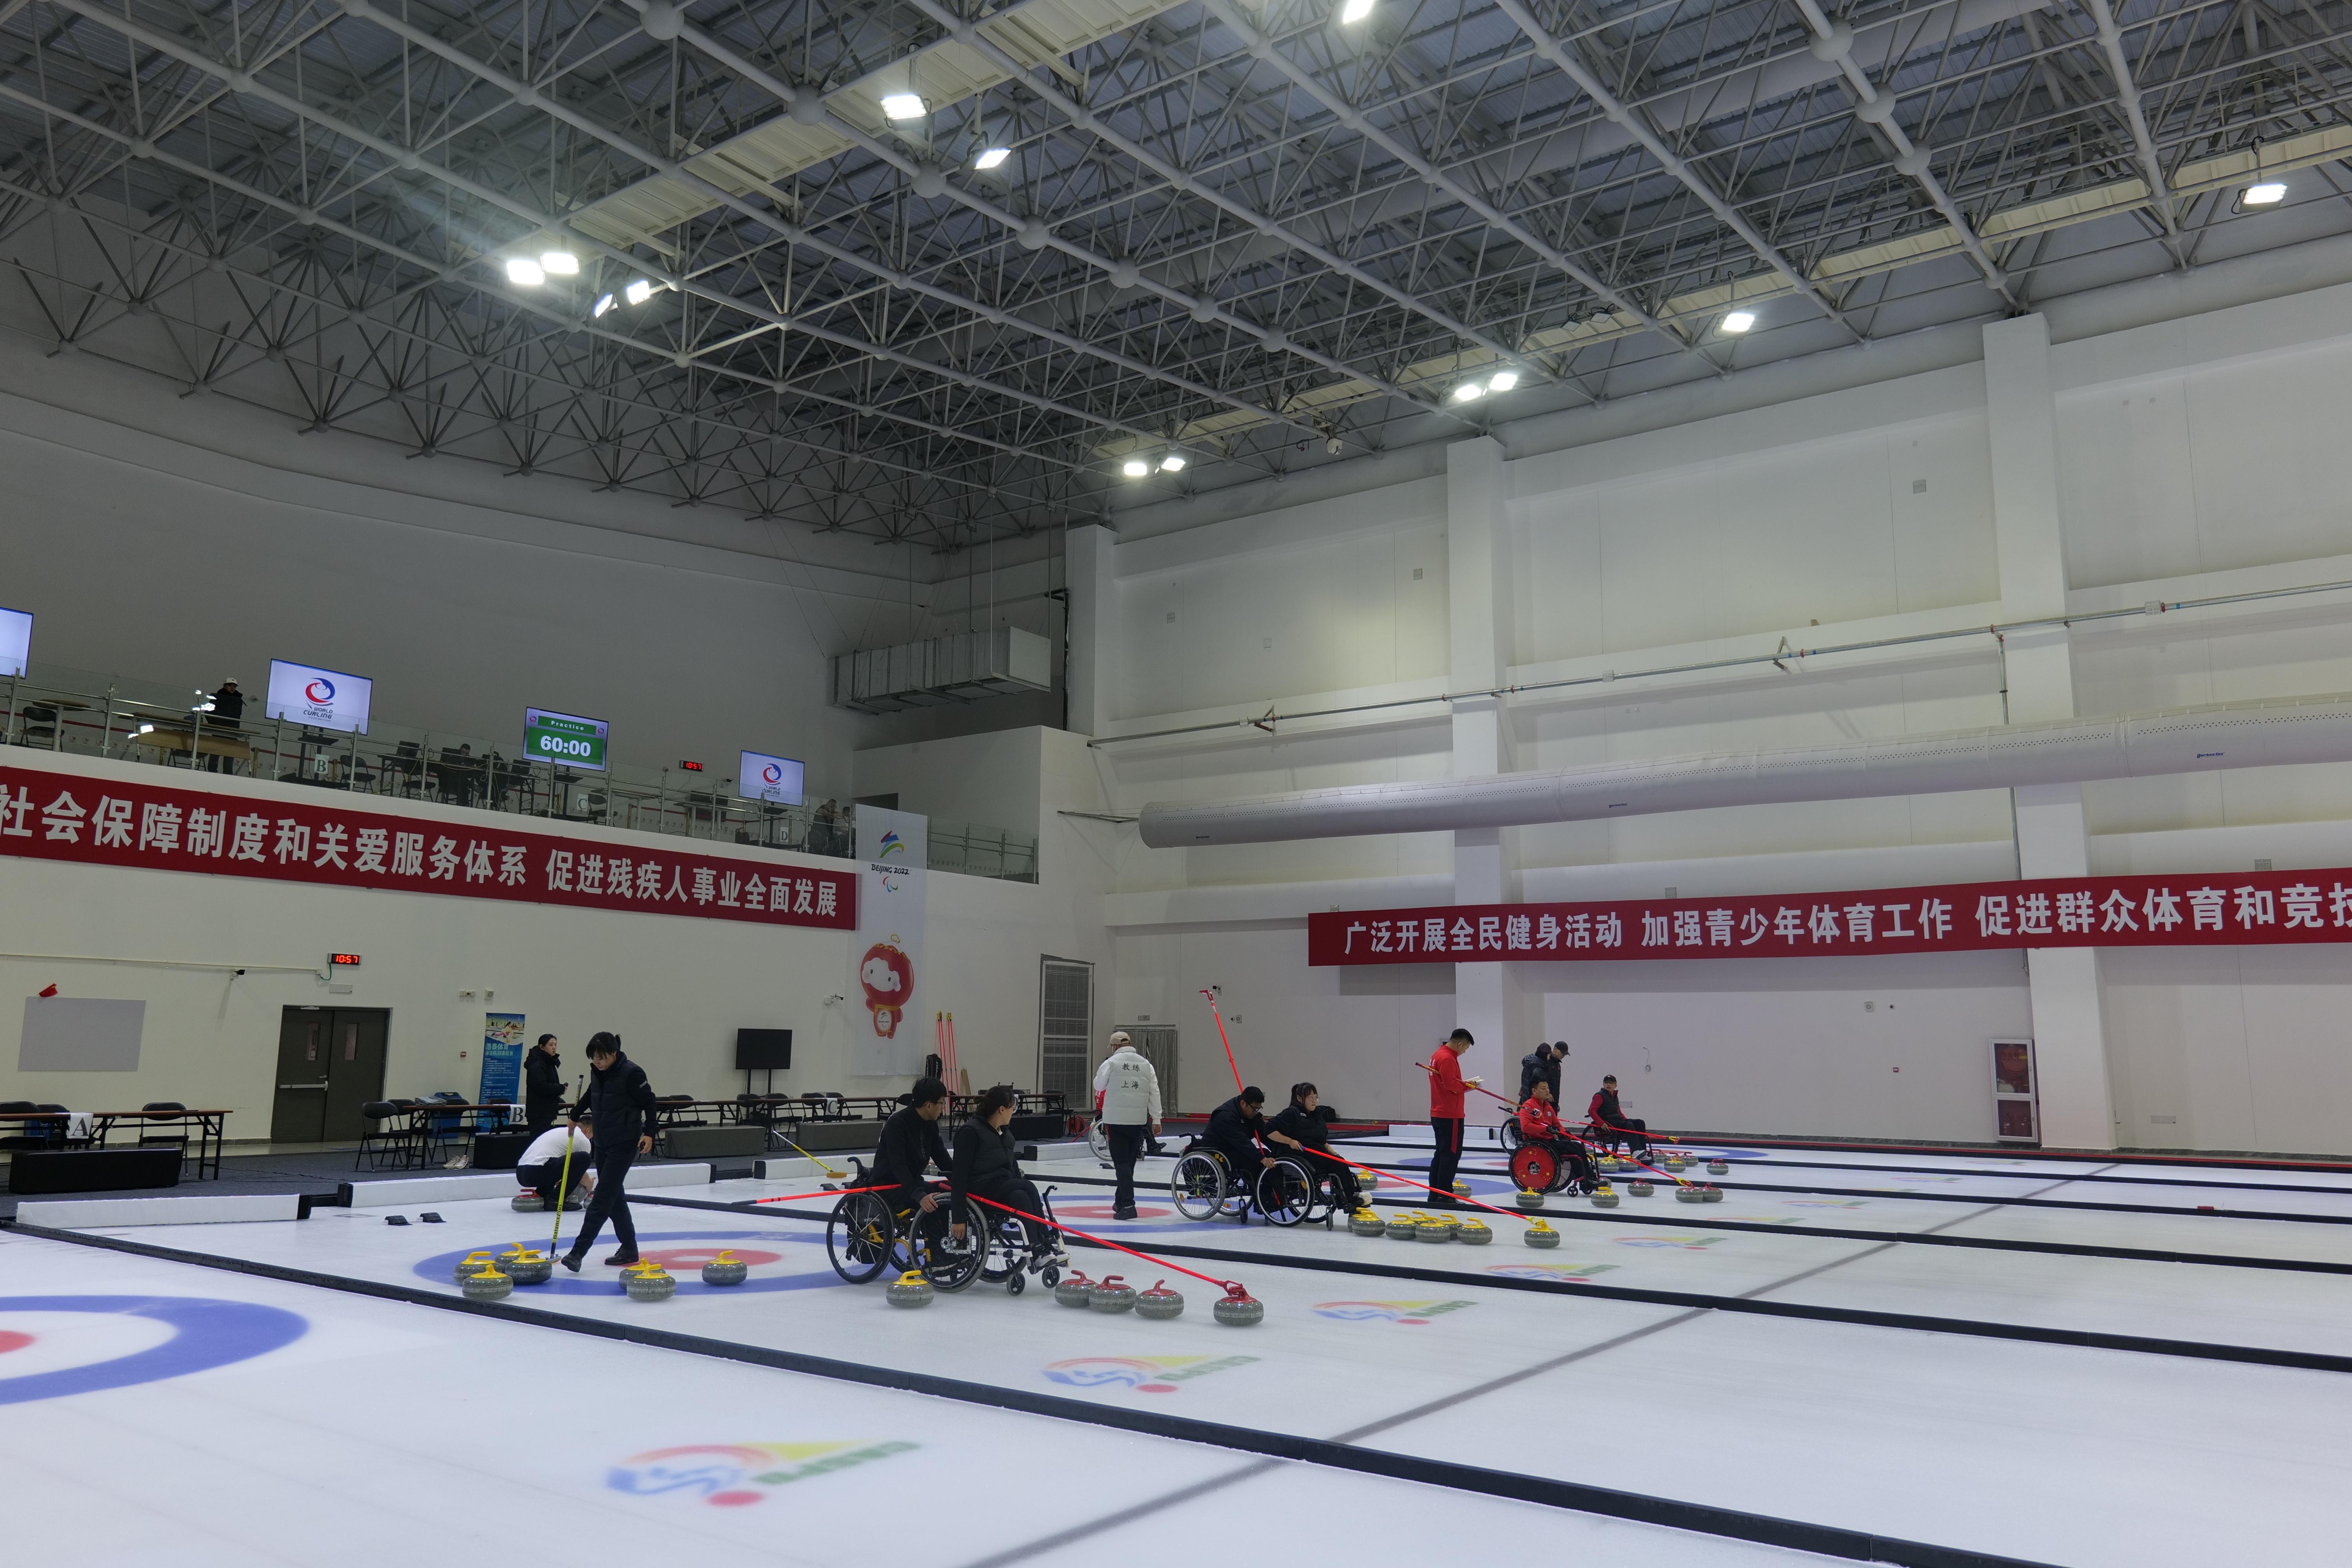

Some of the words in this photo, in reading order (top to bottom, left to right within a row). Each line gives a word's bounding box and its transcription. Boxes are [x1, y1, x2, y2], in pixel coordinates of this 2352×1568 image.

[303, 710, 333, 719] CURLING
[551, 720, 584, 730] Practice
[541, 735, 591, 757] 60:00
[316, 759, 326, 772] B
[578, 798, 587, 810] C
[781, 830, 788, 841] D
[0, 784, 527, 886] 社会保障制度和关爱服务体系
[545, 849, 836, 917] 促进残疾人事业全面发展
[871, 864, 892, 873] BEIJING
[1345, 911, 1621, 954] 广泛开展全民健身活动
[1641, 898, 1952, 946] 加强青少年体育工作
[1122, 1063, 1140, 1072] 教练
[1121, 1080, 1139, 1089] 上海
[828, 1100, 837, 1114] C
[511, 1107, 524, 1123] B
[70, 1117, 89, 1136] A
[553, 1204, 562, 1239] BalancePlus
